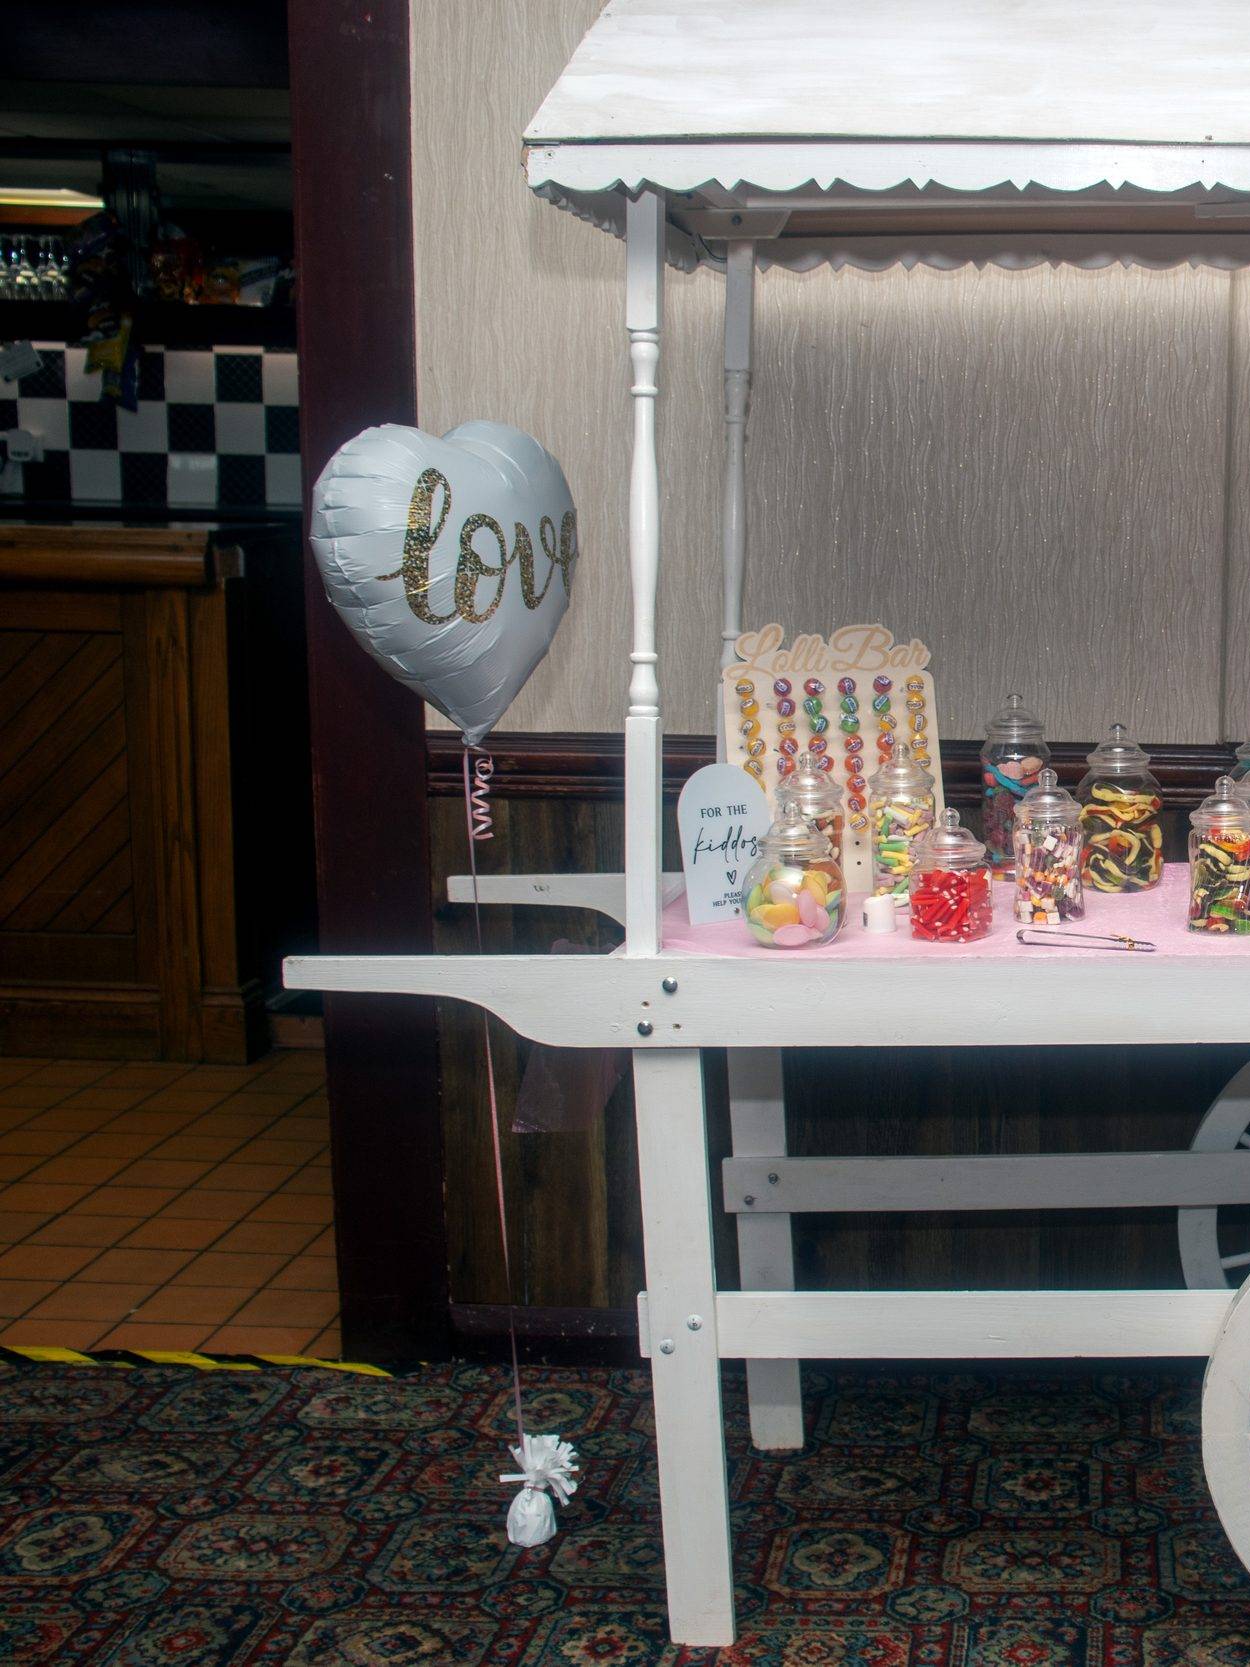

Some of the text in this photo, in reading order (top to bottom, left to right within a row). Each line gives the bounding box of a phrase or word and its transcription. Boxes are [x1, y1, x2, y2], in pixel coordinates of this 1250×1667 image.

[727, 623, 929, 681] Lolli Bar
[701, 804, 748, 819] FOR THE
[693, 825, 758, 865] kiddos
